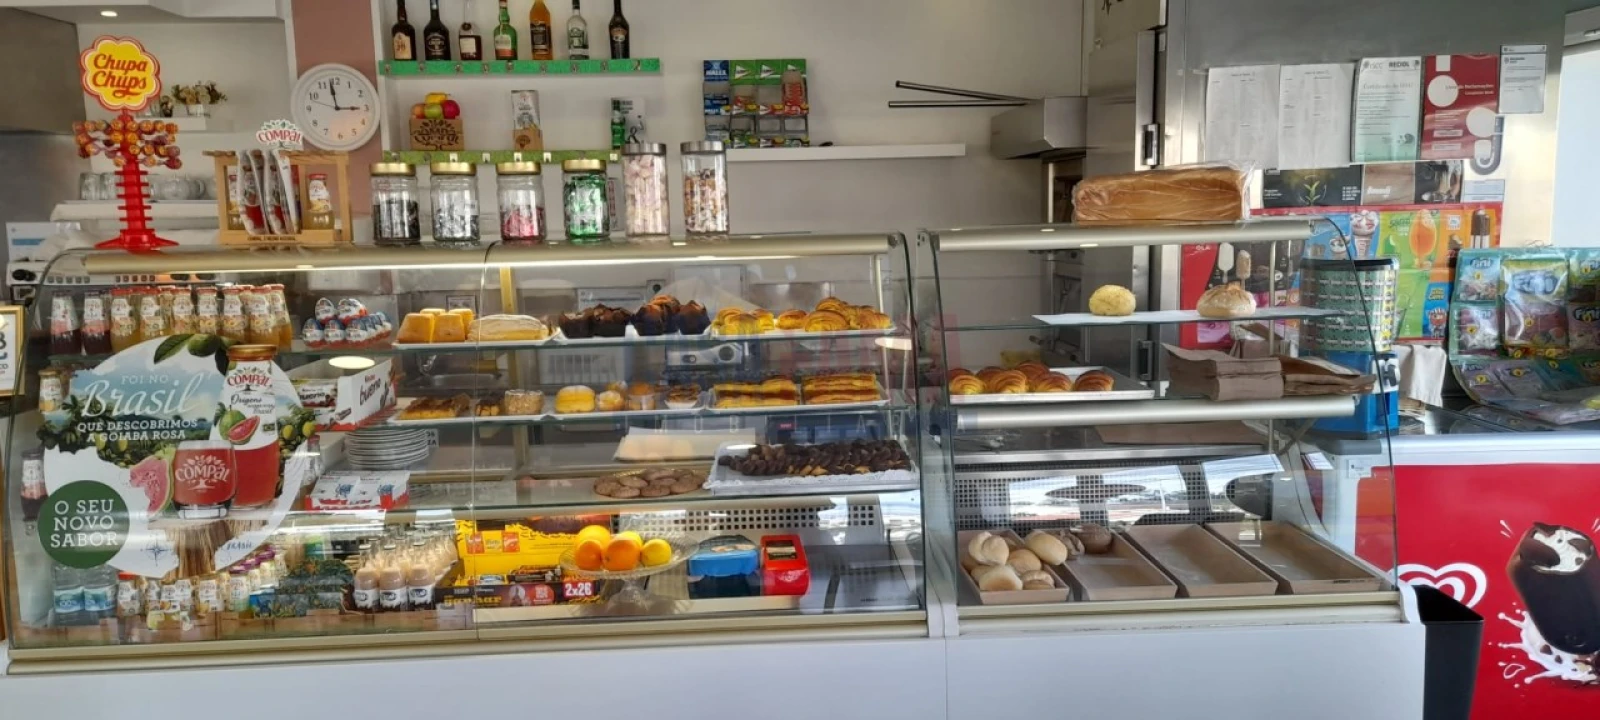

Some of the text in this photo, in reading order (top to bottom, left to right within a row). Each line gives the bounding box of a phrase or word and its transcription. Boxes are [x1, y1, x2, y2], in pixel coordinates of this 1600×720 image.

[93, 53, 148, 75] Chupa
[92, 70, 147, 99] Chups
[318, 81, 327, 89] 11
[309, 92, 319, 100] 10
[357, 90, 363, 98] 2
[363, 104, 369, 112] 3
[360, 118, 366, 126] 4
[351, 128, 357, 136] 5
[121, 374, 169, 385] FOI NO
[81, 372, 204, 417] Brasil
[77, 419, 198, 432] QUE DESCOBRIMOS
[86, 430, 186, 442] A GOIABA ROSA
[54, 499, 114, 515] O SEU
[54, 516, 114, 532] NOVO
[50, 533, 118, 549] SABOR
